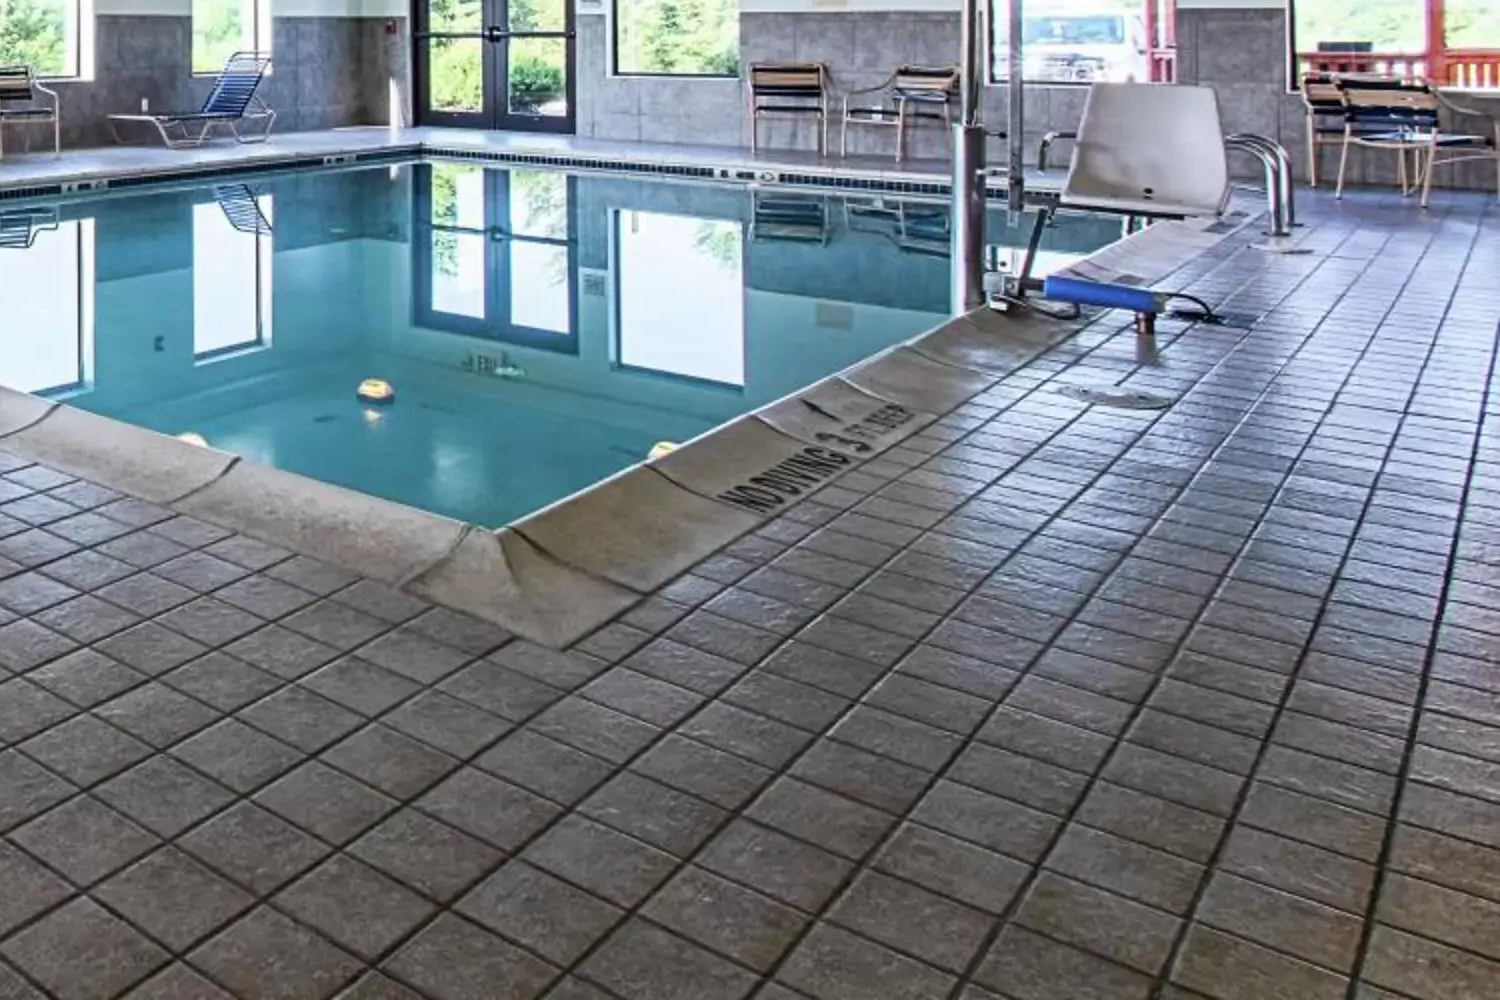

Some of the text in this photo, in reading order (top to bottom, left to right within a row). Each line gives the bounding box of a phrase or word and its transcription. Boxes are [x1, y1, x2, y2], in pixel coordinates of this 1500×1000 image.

[815, 432, 872, 451] 3
[717, 447, 851, 513] NO DIVING
